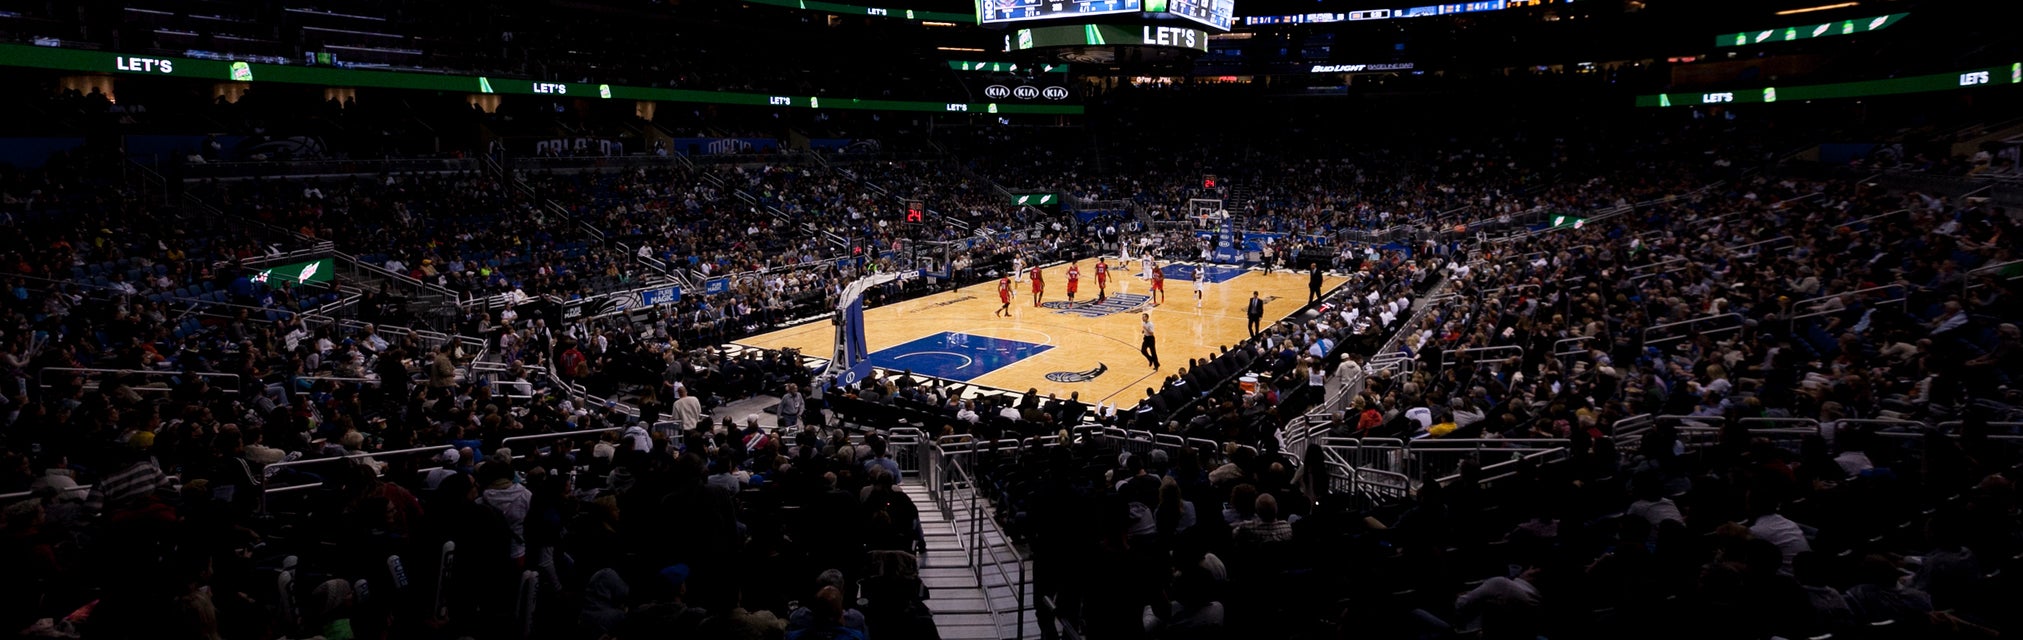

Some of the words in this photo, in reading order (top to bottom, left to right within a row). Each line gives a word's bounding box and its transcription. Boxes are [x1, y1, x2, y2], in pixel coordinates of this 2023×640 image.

[867, 7, 887, 16] LET'S
[1143, 25, 1196, 48] LET'S
[116, 56, 173, 74] LET'S
[1334, 64, 1366, 72] LIGHT
[1959, 71, 1990, 86] LET'S
[533, 82, 566, 95] LET'S
[989, 87, 1006, 96] KIA
[1018, 88, 1035, 97] KIA
[1047, 89, 1064, 97] KIA
[770, 96, 790, 106] LET'S
[1703, 92, 1733, 104] LET'S
[946, 103, 967, 112] LET'S
[536, 137, 624, 157] ORLADO
[1204, 180, 1215, 188] 24
[907, 209, 922, 222] 24
